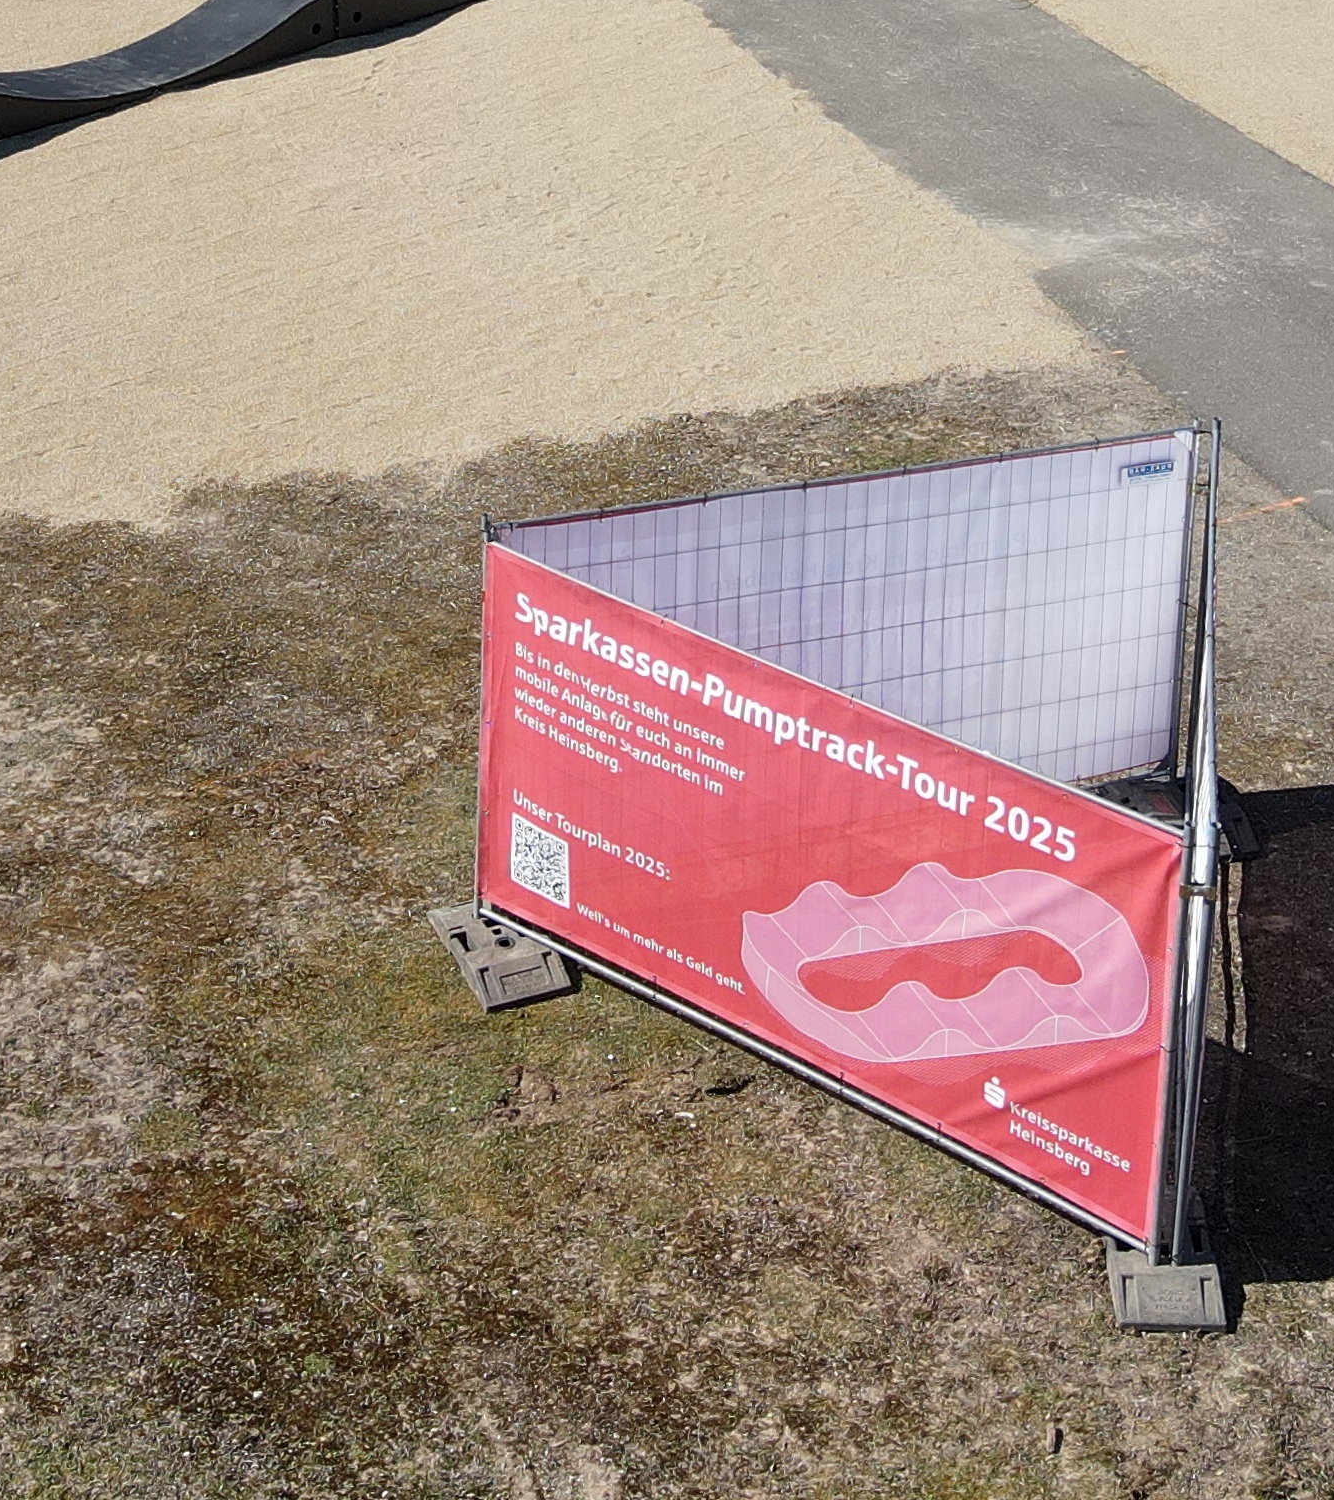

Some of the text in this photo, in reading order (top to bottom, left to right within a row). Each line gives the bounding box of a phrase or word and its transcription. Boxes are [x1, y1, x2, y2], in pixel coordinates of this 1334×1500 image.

[514, 592, 1076, 862] Sparkassen-Pumptrack-Tour 2025
[514, 704, 623, 774] Kreis Heinsberg.
[514, 686, 723, 796] wieder anderen Standorten im
[515, 641, 725, 751] Bis in den Herbst steht unsere
[515, 665, 746, 782] mobile Anlage für euch an immer
[513, 788, 672, 881] Unser Tourplan 2025:
[576, 902, 746, 996] Weil's um mehr als Geld geht.
[1009, 1100, 1131, 1173] Kreissparkasse
[1009, 1119, 1091, 1176] Heinsberg
